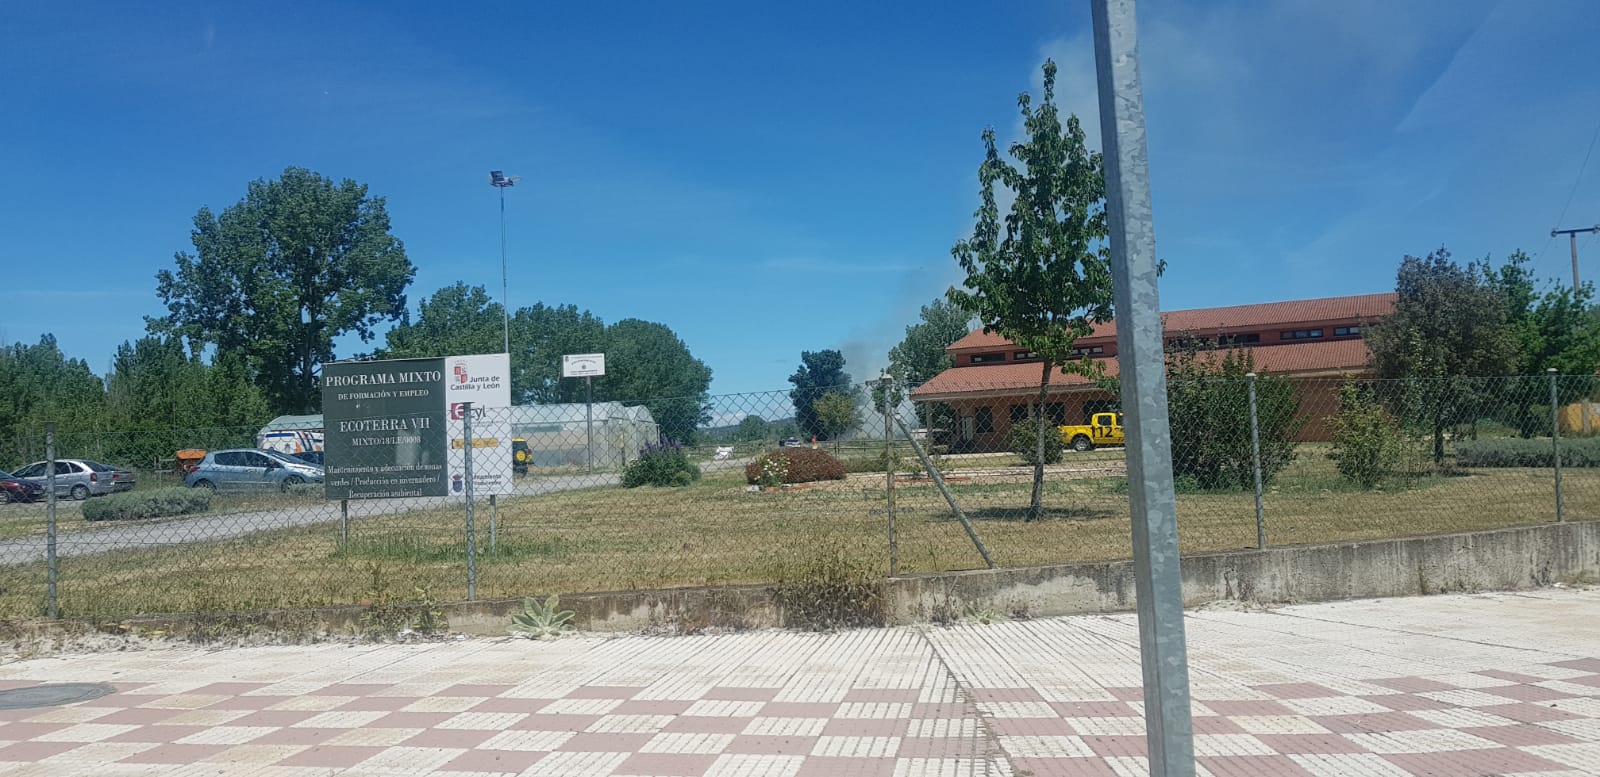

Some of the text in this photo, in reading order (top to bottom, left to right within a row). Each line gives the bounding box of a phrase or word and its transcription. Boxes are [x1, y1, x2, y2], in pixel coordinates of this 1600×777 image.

[326, 370, 441, 387] PROGRAMA MIXTO
[350, 390, 391, 400] FORMACIÓN
[400, 389, 429, 398] EMPLEO
[340, 418, 430, 432] ECOTERRA VII
[356, 476, 390, 486] Producción
